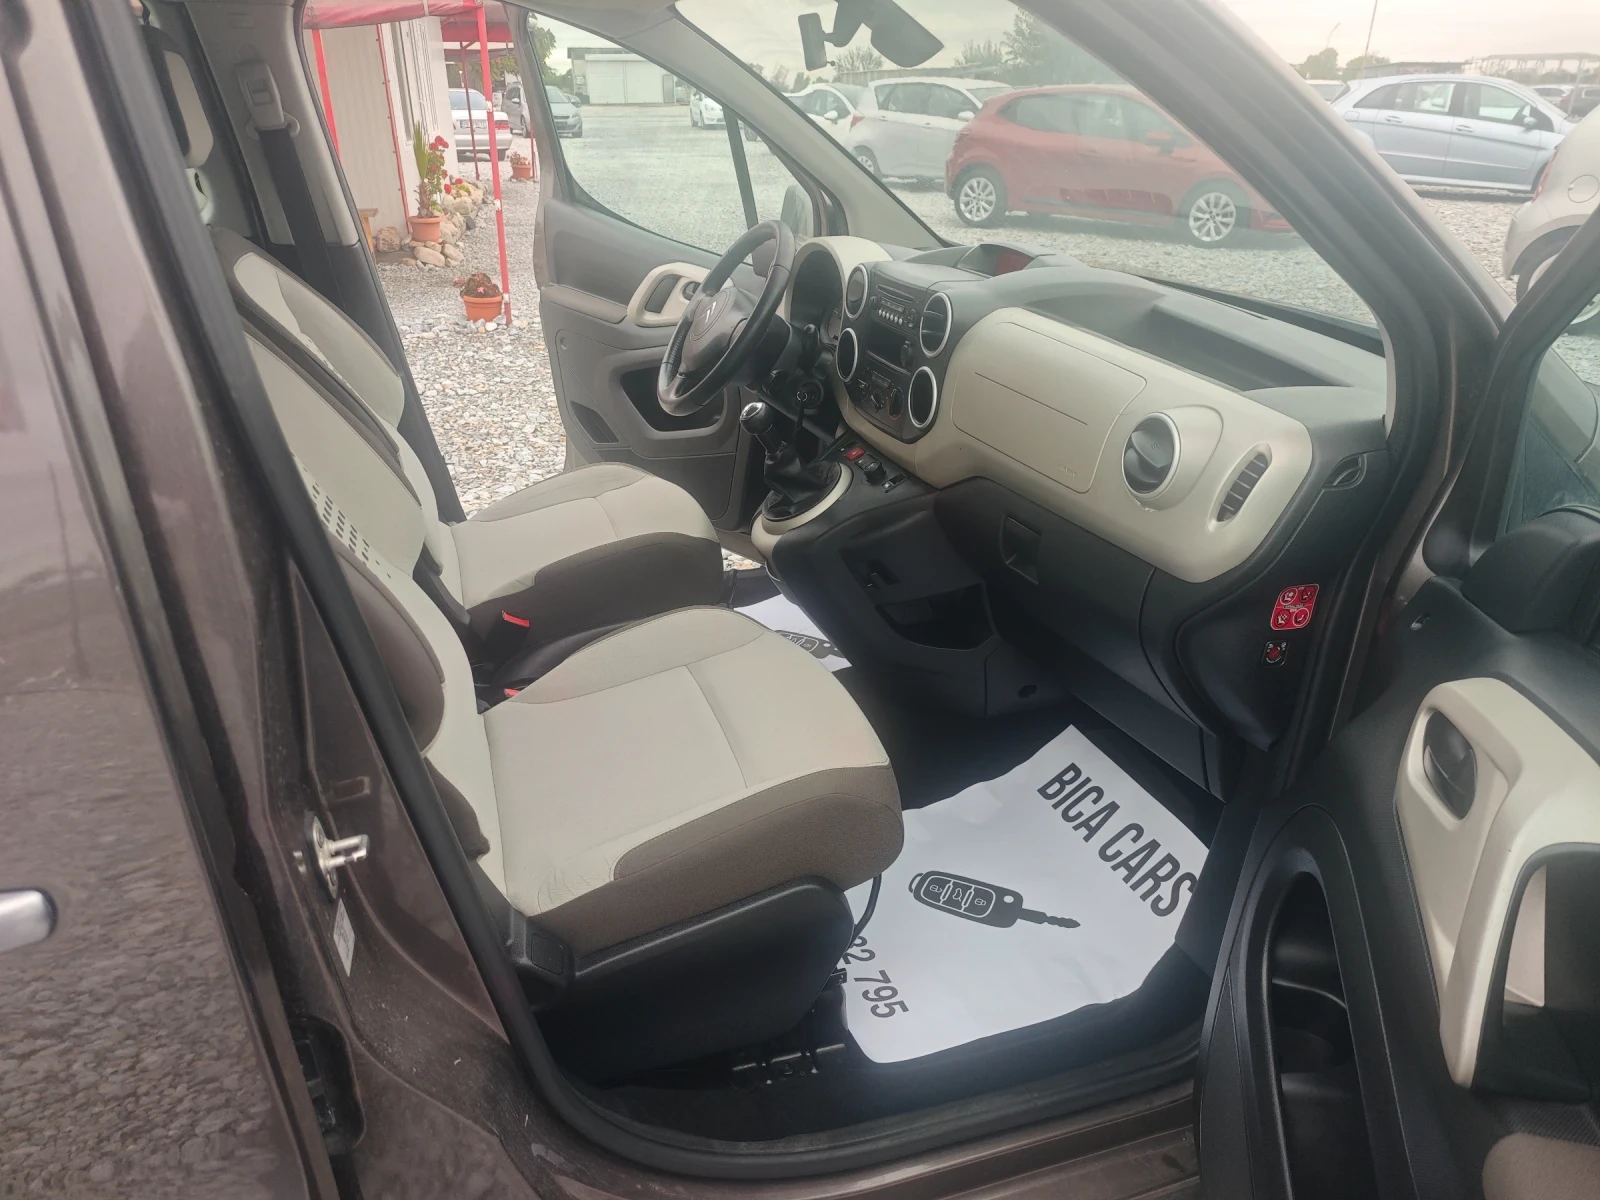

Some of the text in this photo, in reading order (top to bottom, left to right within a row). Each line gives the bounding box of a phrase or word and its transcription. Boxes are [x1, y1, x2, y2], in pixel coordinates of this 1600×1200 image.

[1036, 762, 1198, 917] BICA CARS
[853, 969, 910, 1018] 795
